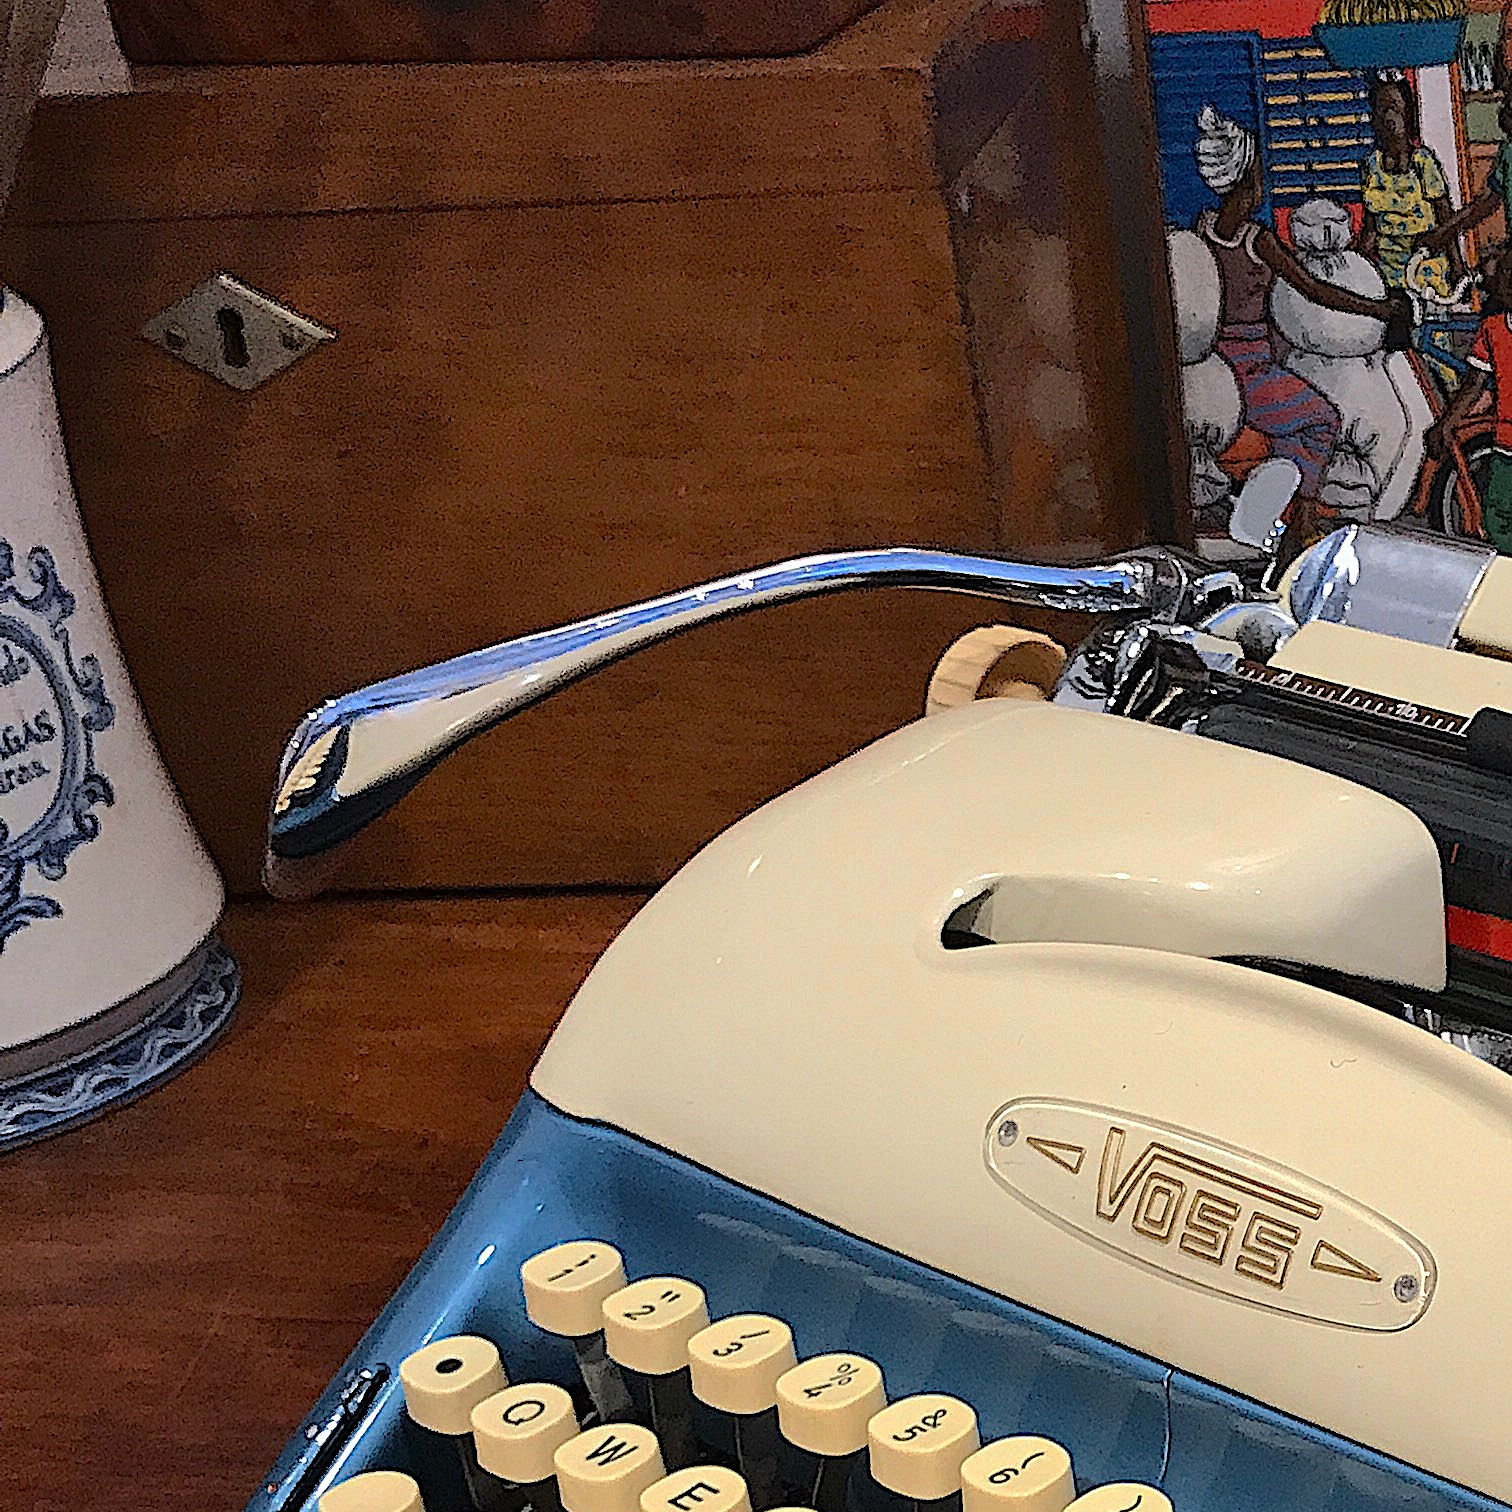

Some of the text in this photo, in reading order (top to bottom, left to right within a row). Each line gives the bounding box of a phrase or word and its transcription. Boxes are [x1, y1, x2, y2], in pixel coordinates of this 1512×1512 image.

[1097, 1126, 1323, 1290] VOSS
[623, 1305, 656, 1321] 2
[712, 1342, 744, 1357] 3
[803, 1383, 832, 1399] 4
[502, 1400, 546, 1426] Q
[892, 1422, 929, 1442] 5
[584, 1434, 639, 1467] W
[988, 1467, 1019, 1484] 6
[667, 1482, 720, 1512] E
